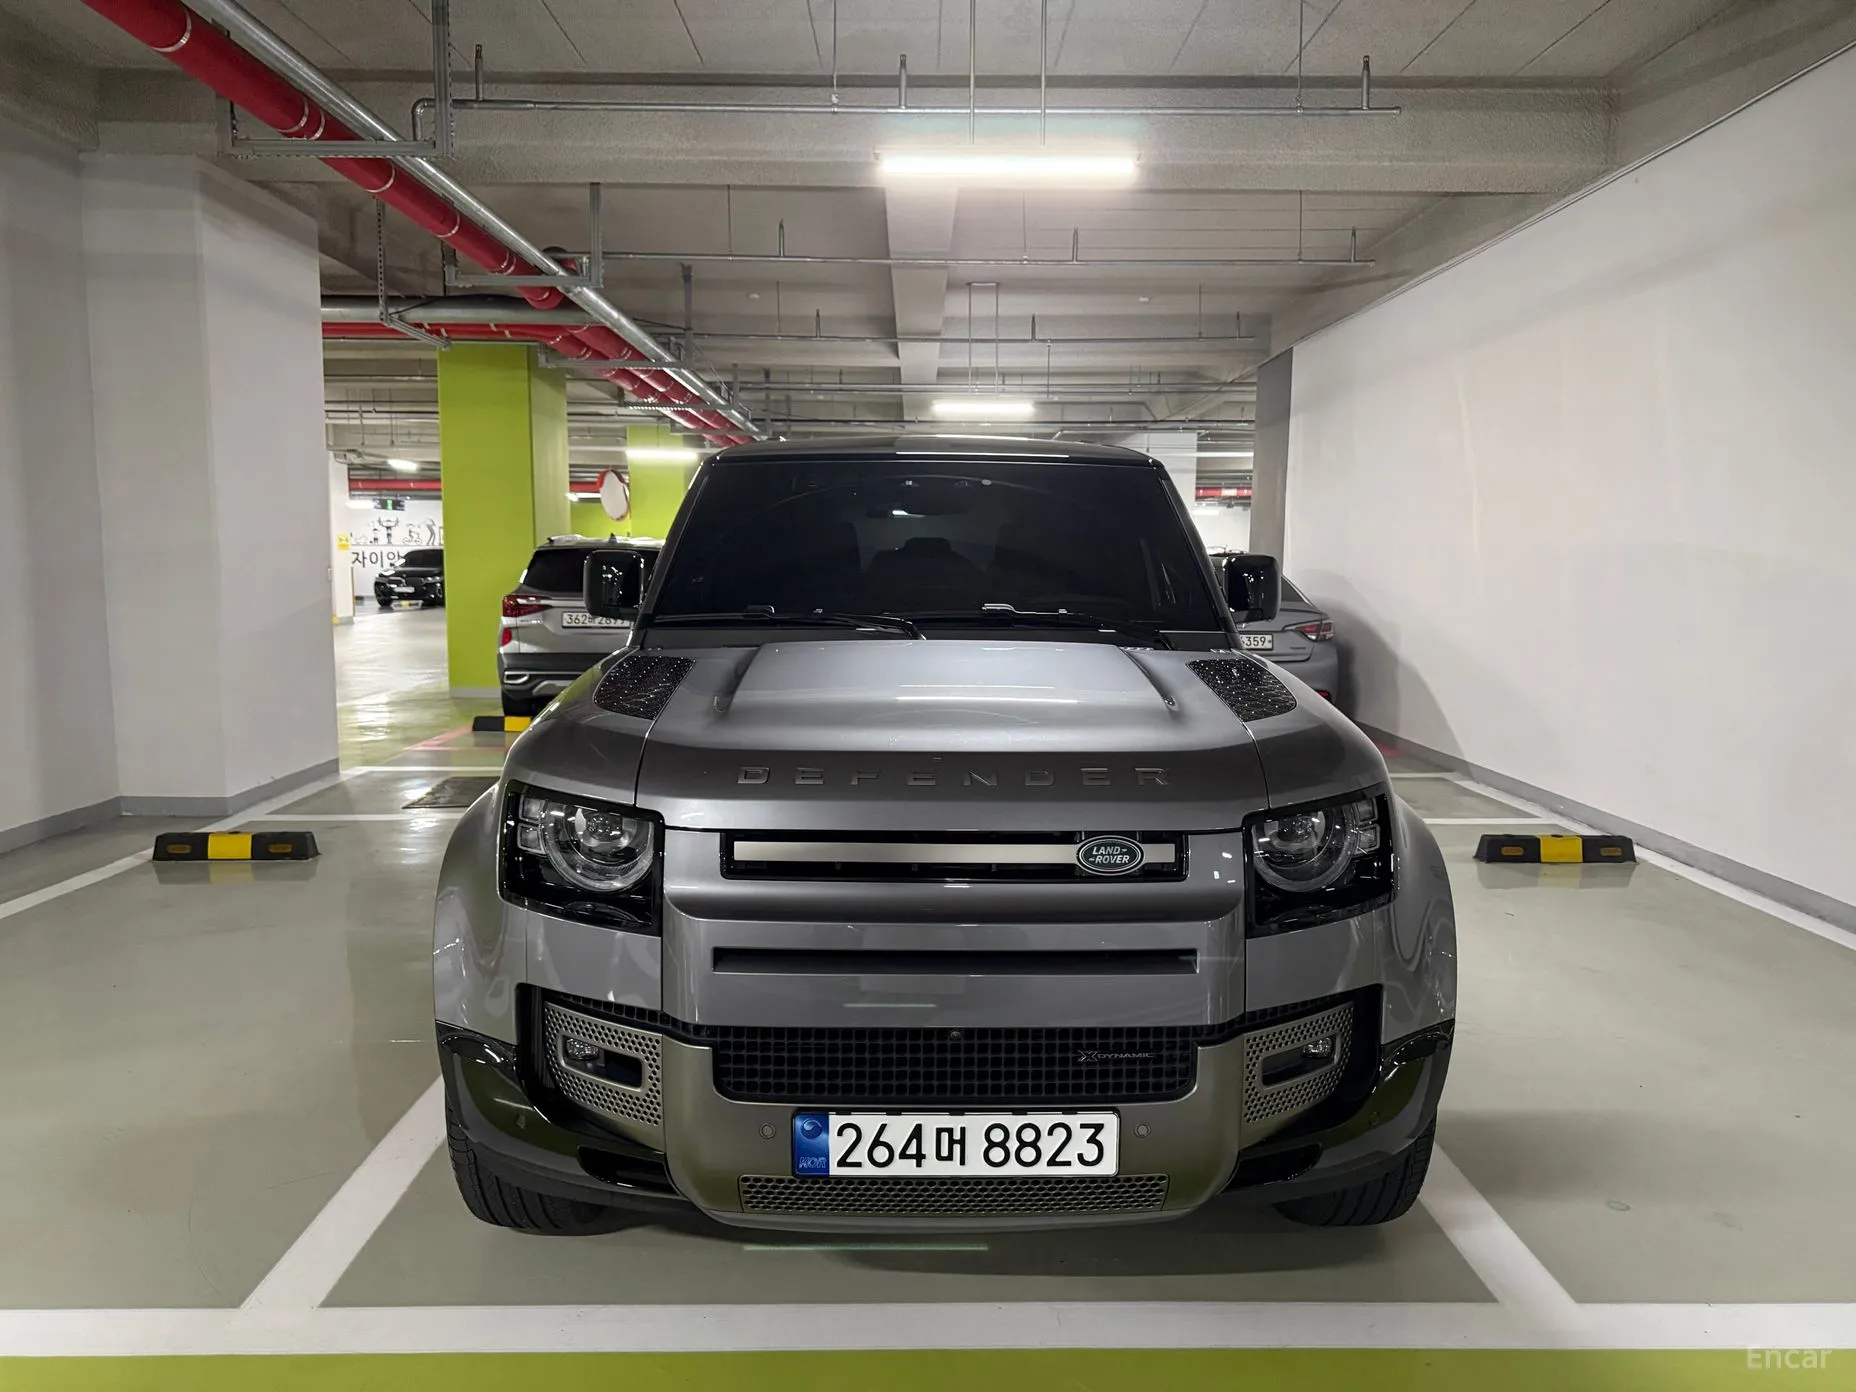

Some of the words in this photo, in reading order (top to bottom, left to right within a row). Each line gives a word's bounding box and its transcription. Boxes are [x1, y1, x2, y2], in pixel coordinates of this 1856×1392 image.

[736, 766, 1171, 786] DEFENDER
[835, 1122, 966, 1168] 264머
[982, 1122, 1106, 1168] 8823
[799, 1156, 827, 1169] KOR
